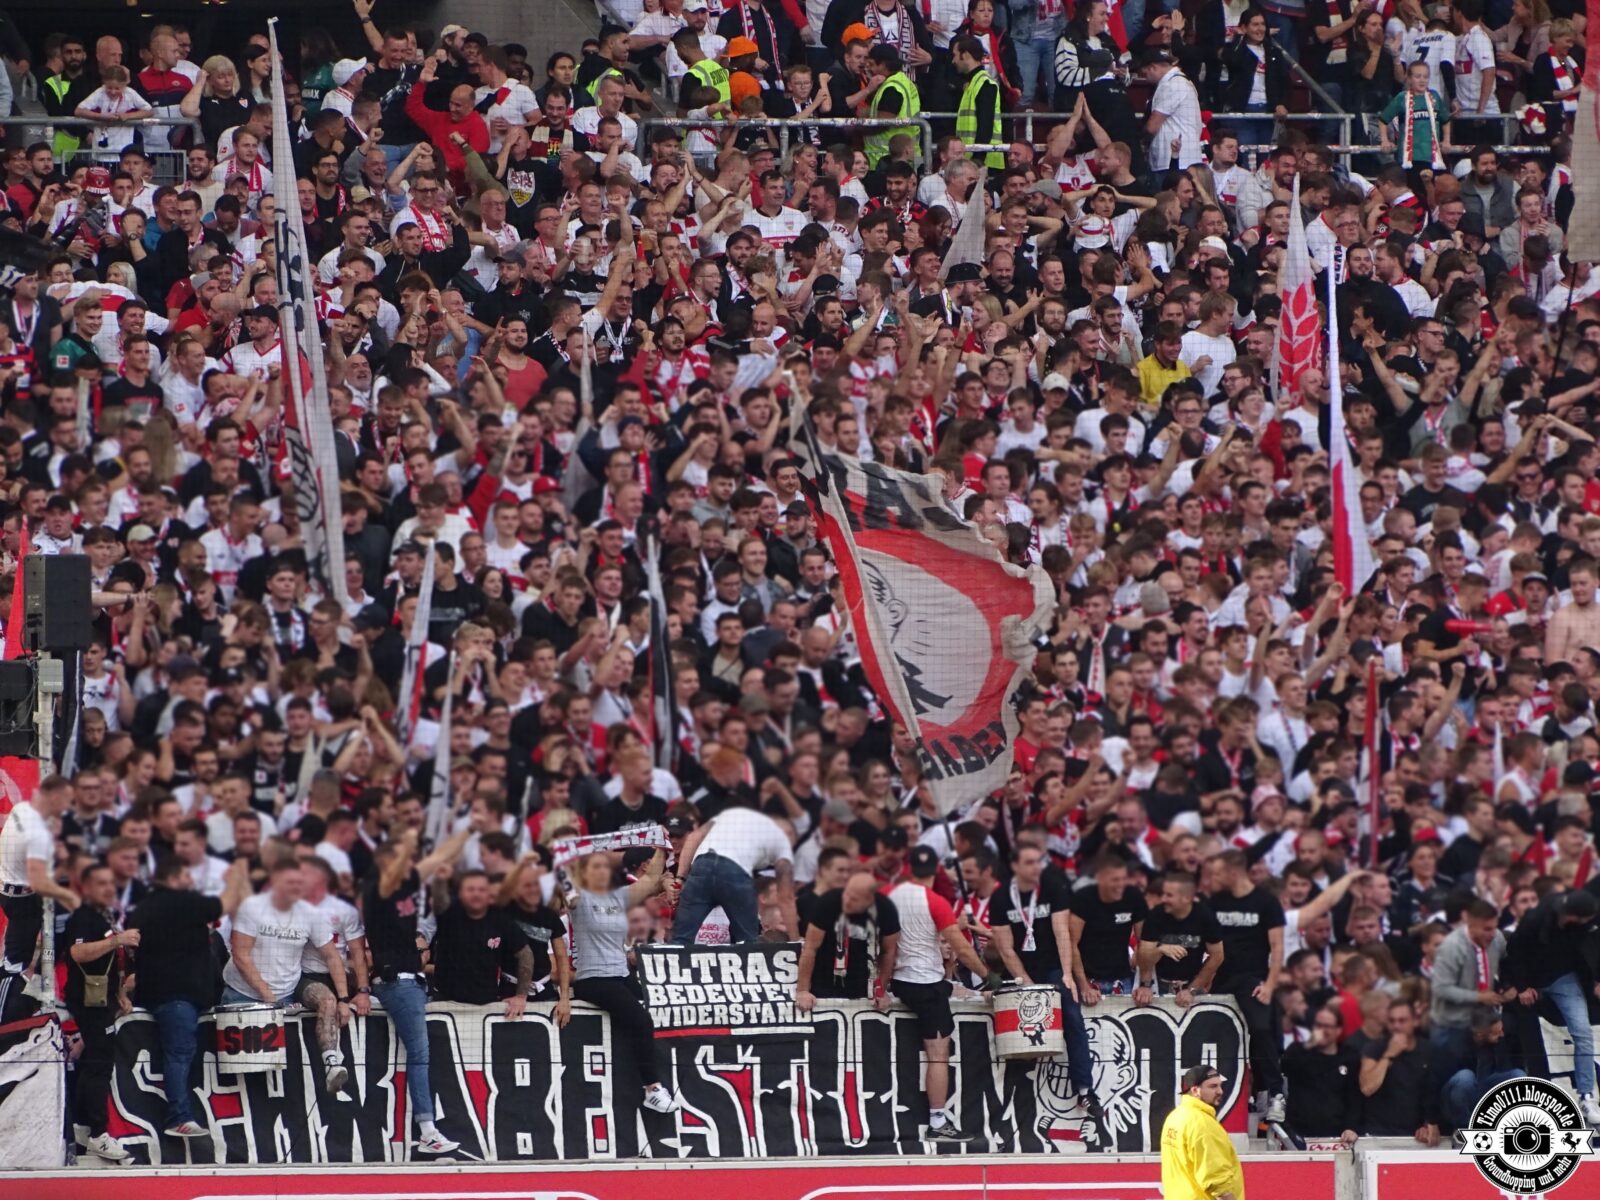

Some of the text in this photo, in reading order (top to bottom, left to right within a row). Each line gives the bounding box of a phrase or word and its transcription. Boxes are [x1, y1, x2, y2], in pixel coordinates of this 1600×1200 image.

[641, 950, 799, 985] ULTRAS
[646, 983, 799, 1006] BEDEUTET
[649, 1001, 813, 1028] WIDERSTAND
